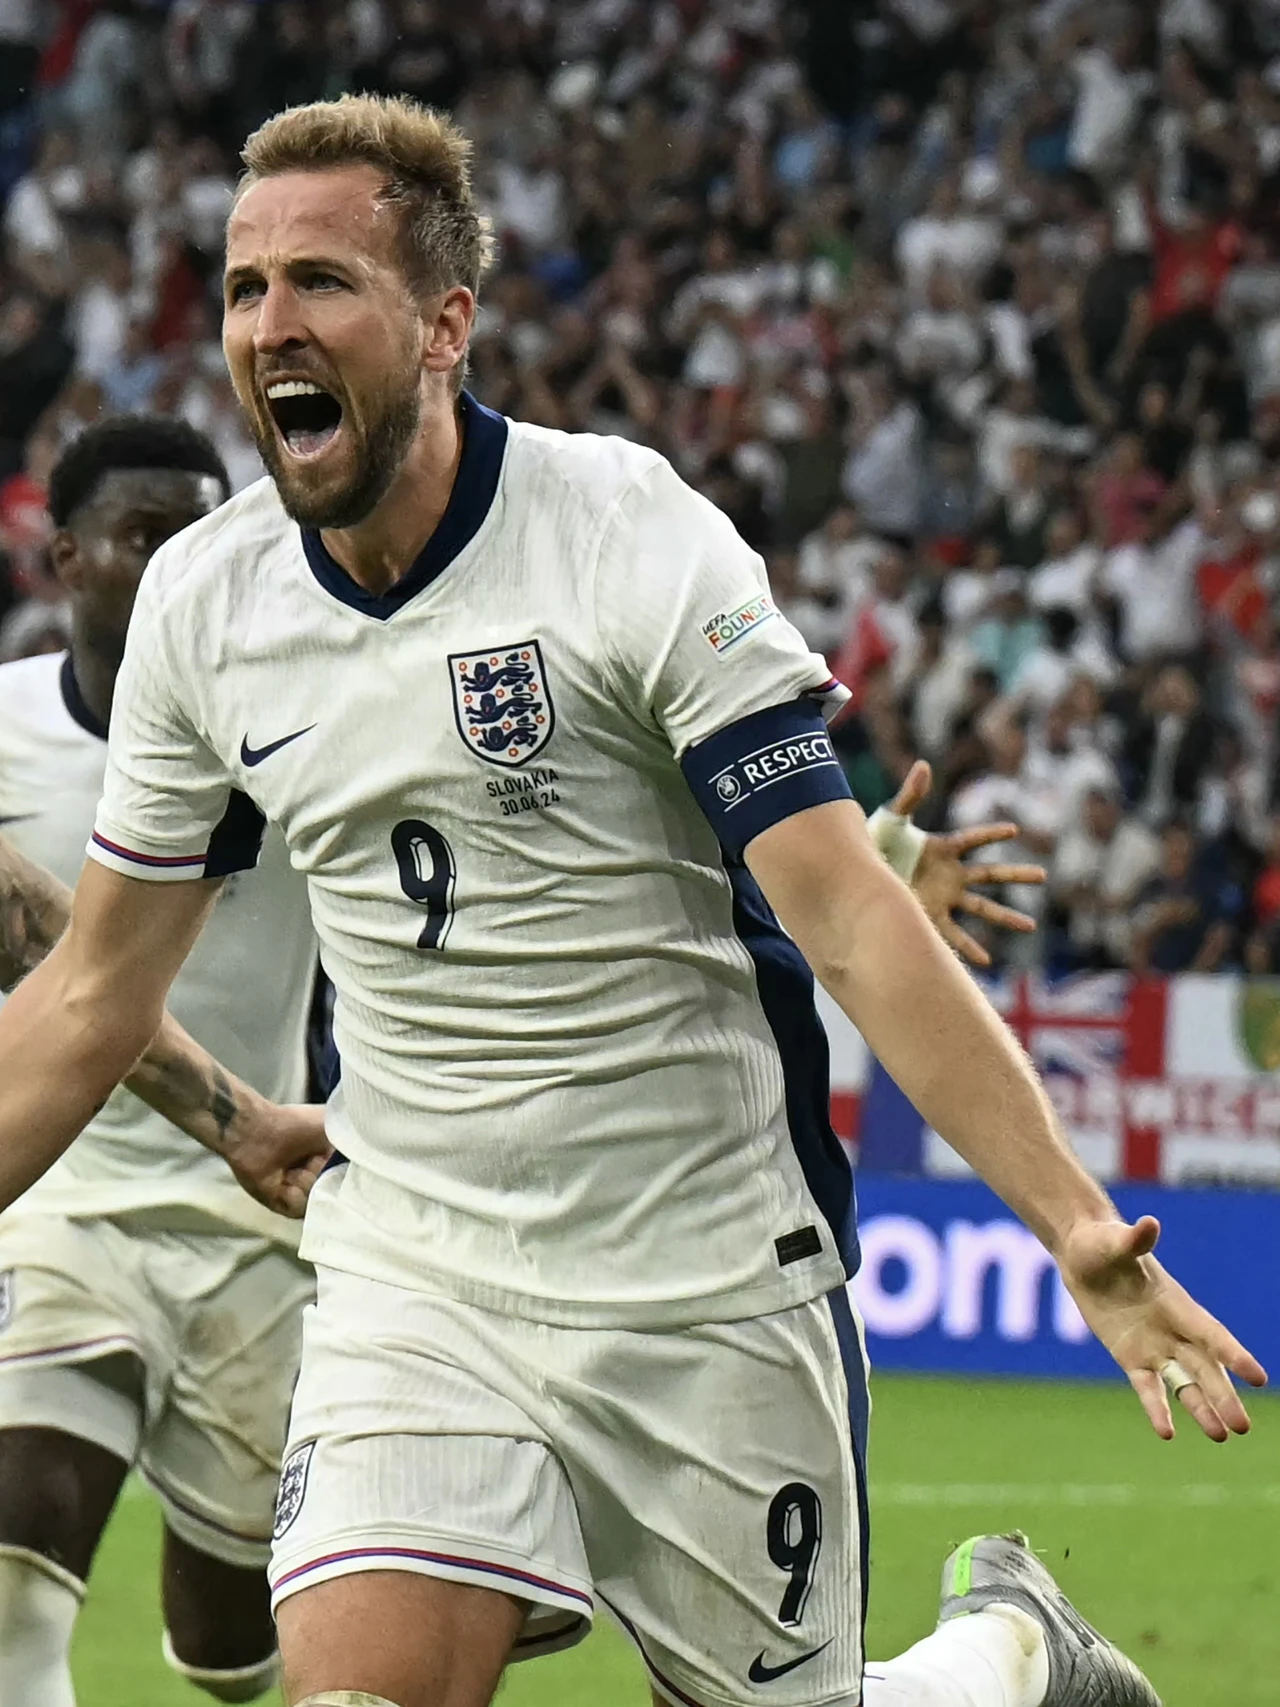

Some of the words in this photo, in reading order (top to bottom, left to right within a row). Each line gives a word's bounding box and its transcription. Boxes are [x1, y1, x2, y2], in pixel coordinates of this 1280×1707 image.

[702, 613, 727, 635] UEFA
[743, 738, 833, 784] RESPECT
[486, 768, 559, 797] SLOVAKIA
[500, 788, 561, 816] 30.06.24
[391, 819, 457, 951] 9
[767, 1482, 822, 1628] 9
